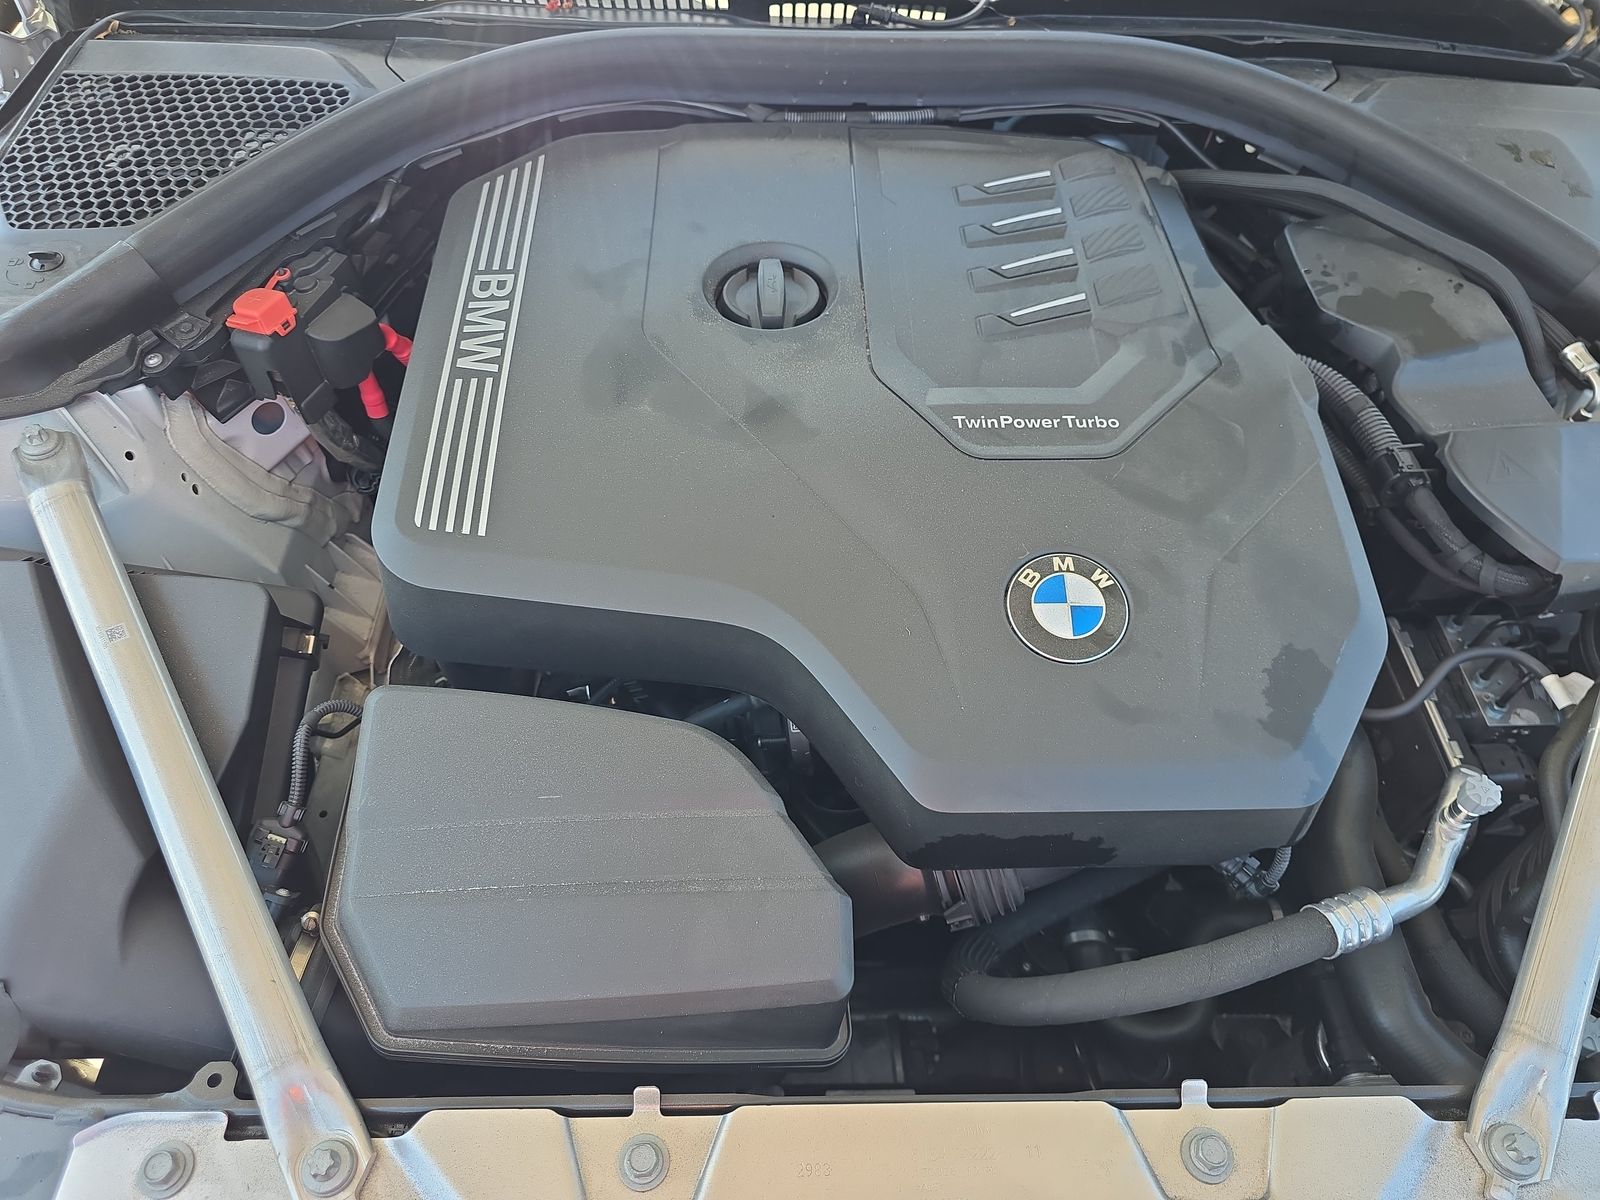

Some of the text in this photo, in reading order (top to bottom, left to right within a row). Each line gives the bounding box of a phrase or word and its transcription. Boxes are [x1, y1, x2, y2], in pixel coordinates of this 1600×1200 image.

[456, 273, 515, 373] BMW
[1062, 415, 1120, 429] Turbo
[1018, 556, 1114, 589] BMW
